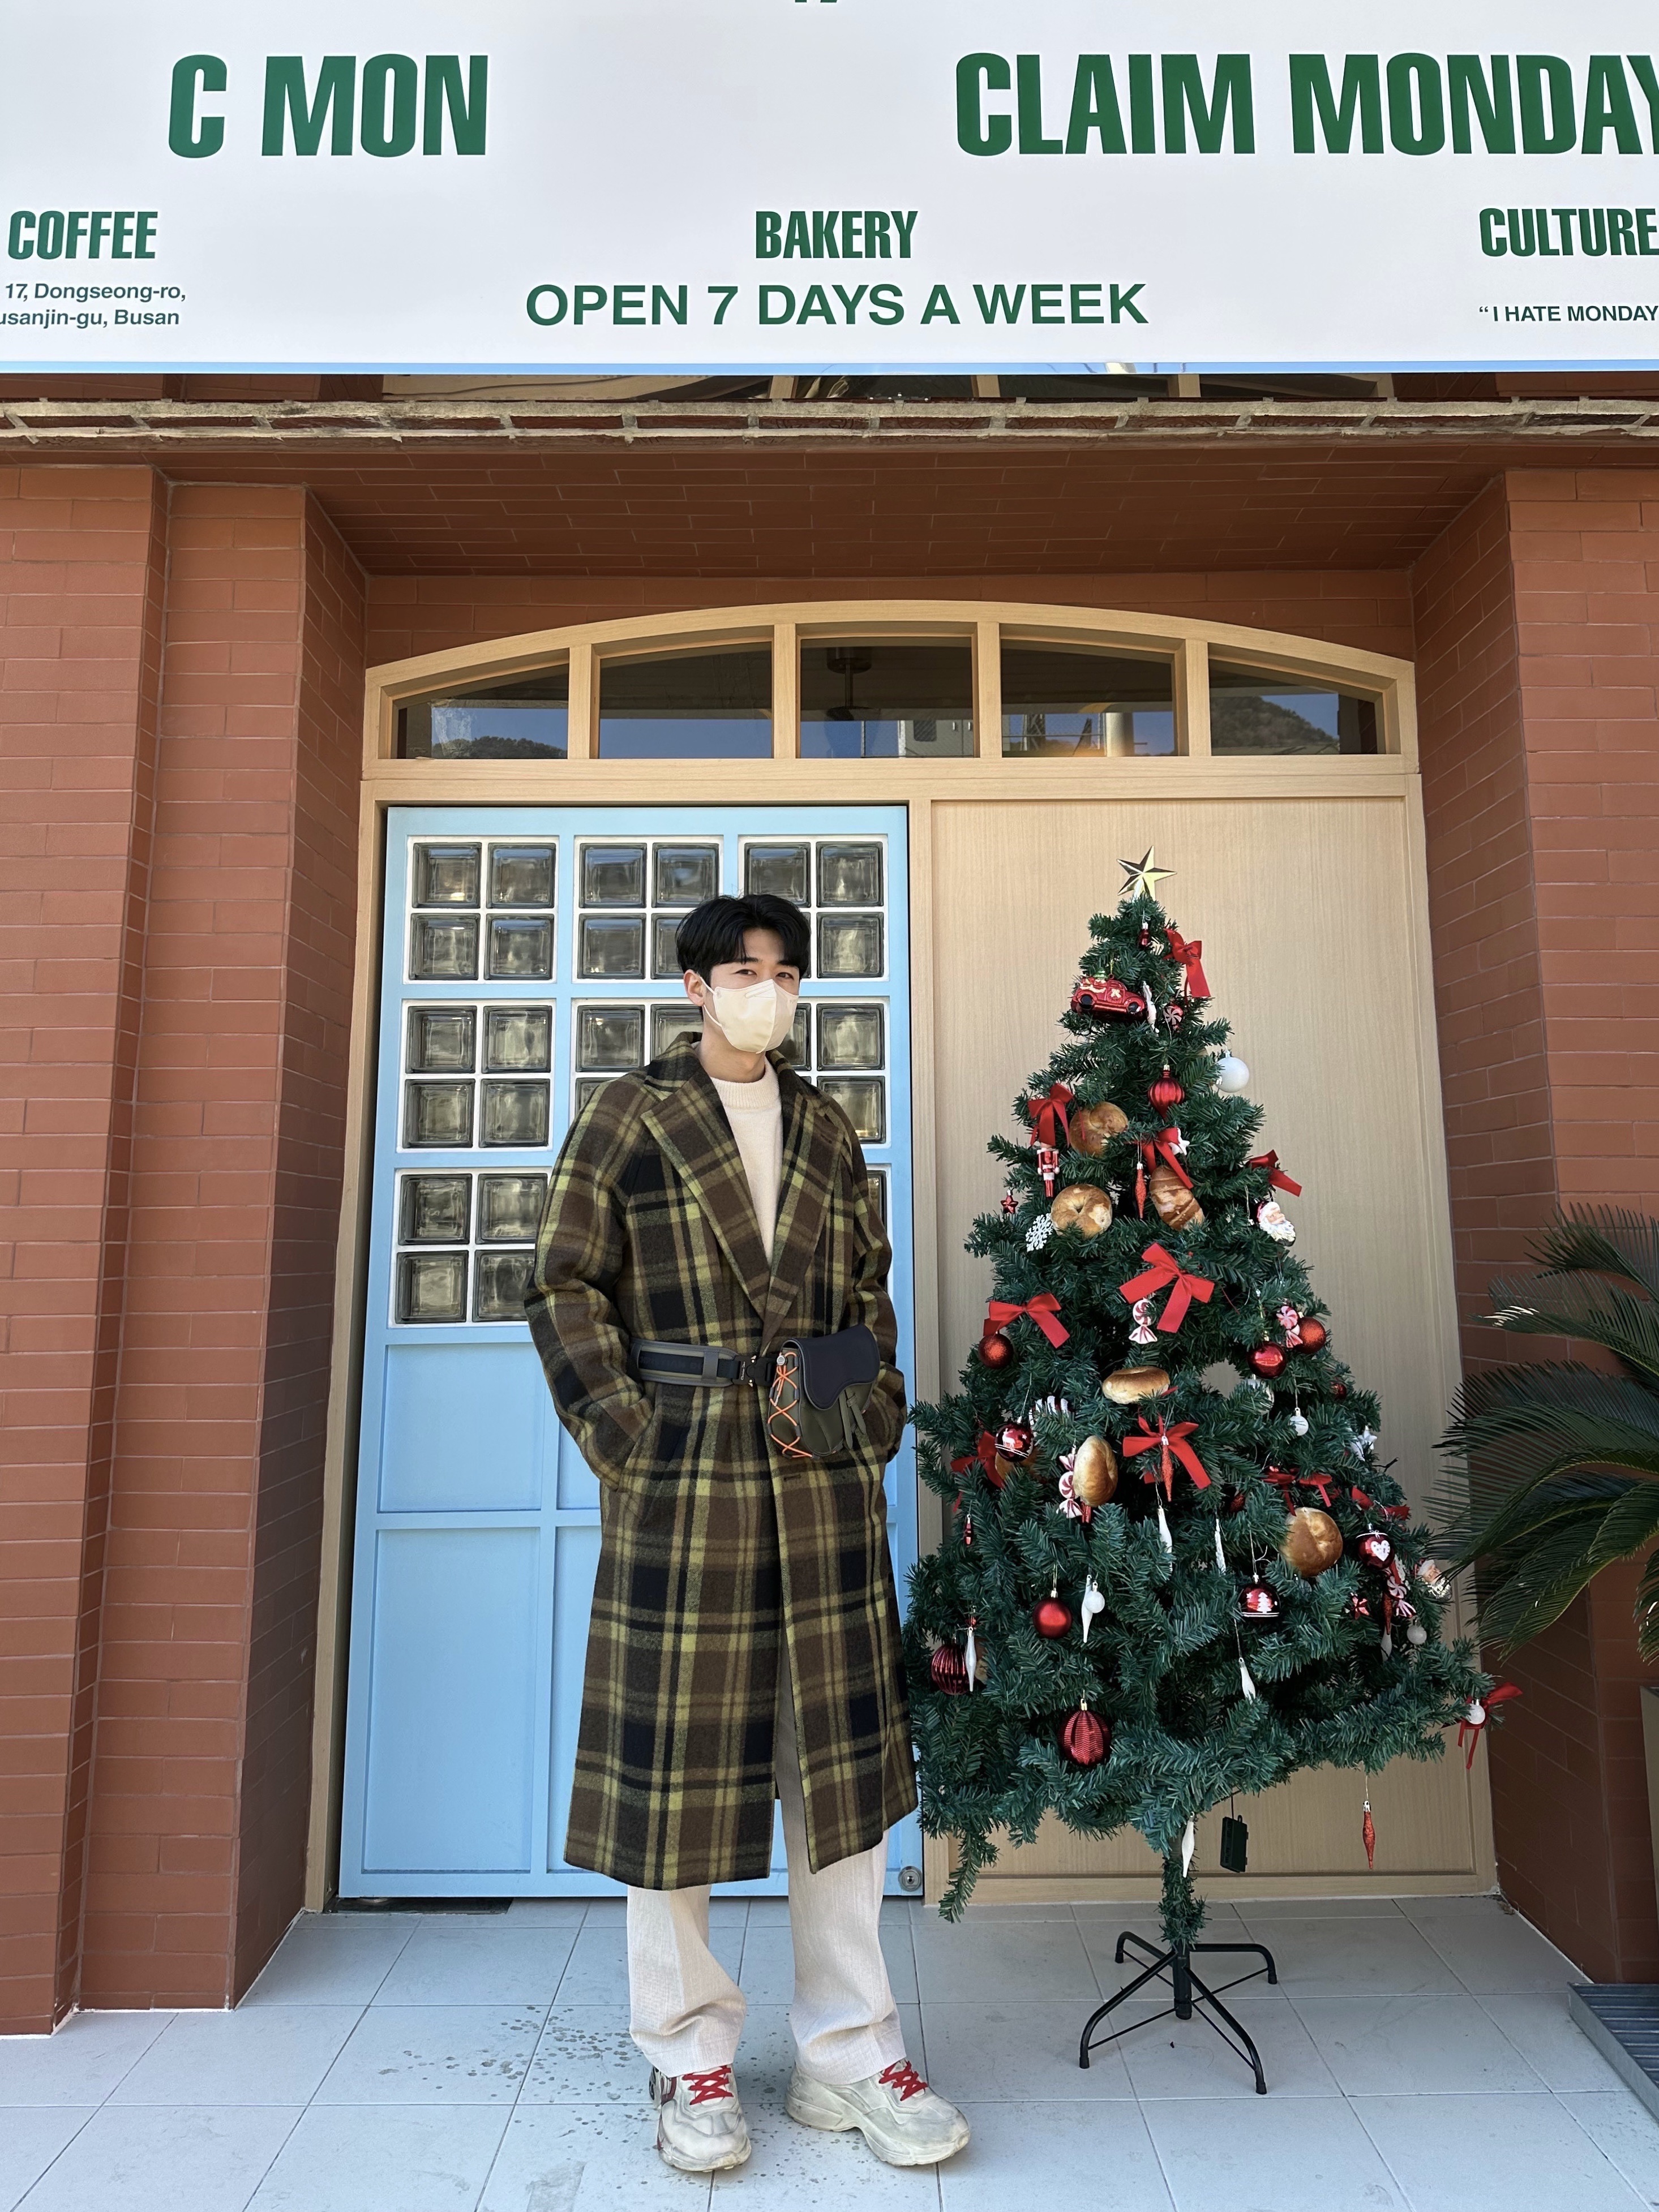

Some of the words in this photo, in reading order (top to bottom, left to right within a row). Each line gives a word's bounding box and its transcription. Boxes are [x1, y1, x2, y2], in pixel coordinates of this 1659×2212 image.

[168, 54, 228, 158] C
[262, 53, 488, 158] MON
[955, 52, 1255, 157] CLAIM
[7, 211, 158, 260] COFFEE
[756, 211, 919, 259] BAKERY
[1479, 208, 1659, 257] CULTURE
[6, 283, 28, 302] 17,
[35, 283, 186, 303] Dongseong-ro,
[114, 309, 179, 325] Busan
[526, 285, 688, 326] OPEN
[708, 286, 738, 325] 7
[759, 284, 904, 325] DAYS
[920, 284, 961, 325] A
[972, 284, 1149, 324] WEEK
[1504, 306, 1561, 322] HATE
[1567, 305, 1659, 321] MONDAY
